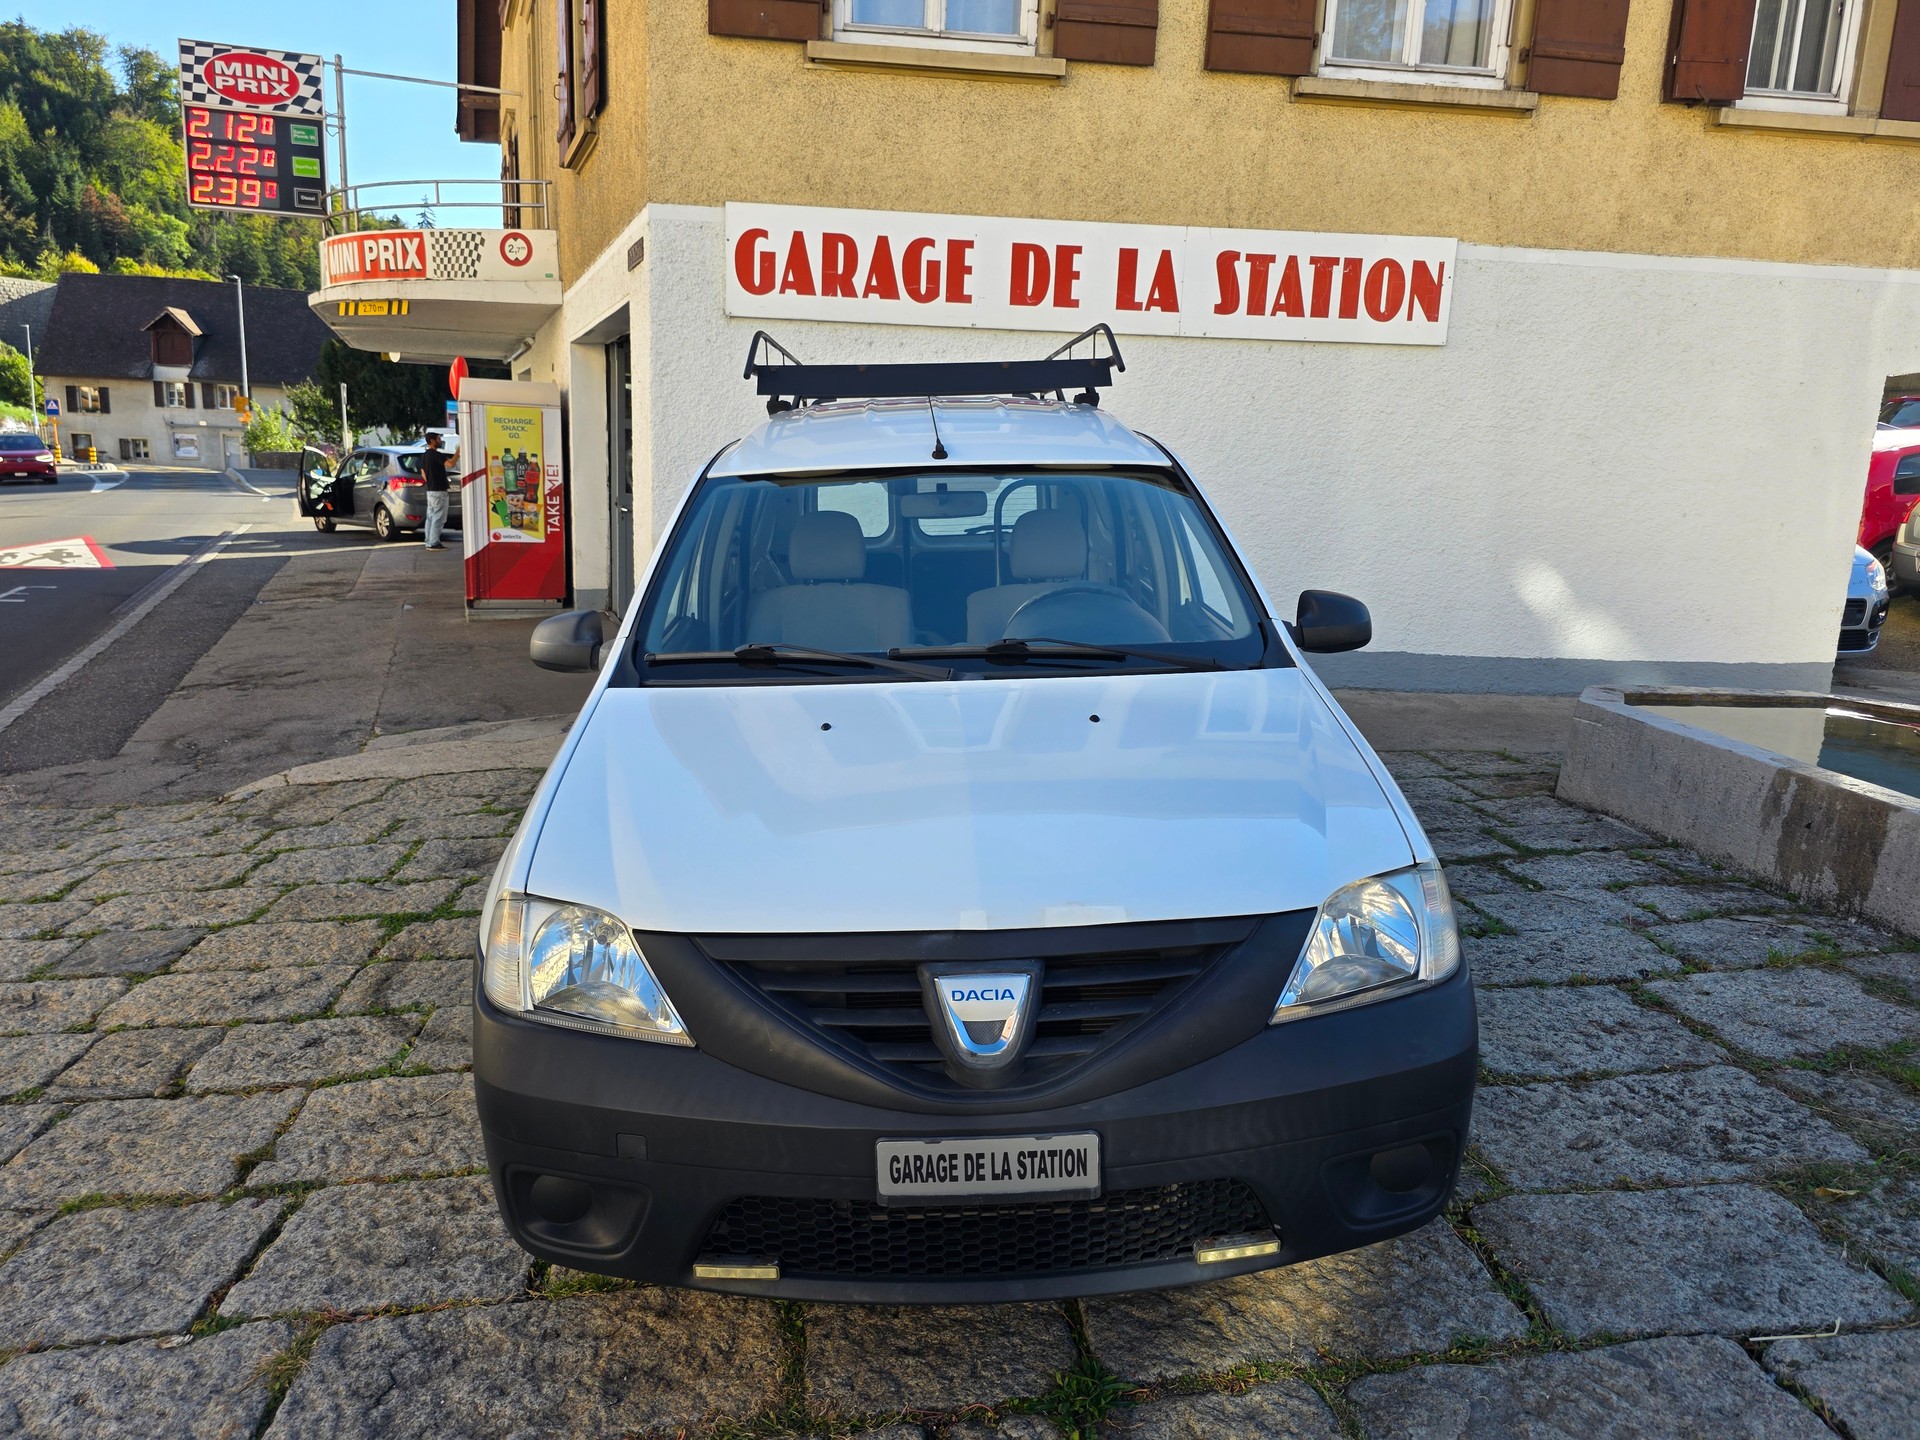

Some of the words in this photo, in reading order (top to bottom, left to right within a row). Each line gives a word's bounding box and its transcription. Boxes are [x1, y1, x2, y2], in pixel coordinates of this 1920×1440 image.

[213, 60, 290, 82] MINI
[214, 75, 292, 98] PRIX
[328, 241, 360, 277] MINI
[363, 237, 423, 272] PRIX
[734, 227, 975, 305] GARAGE
[1010, 242, 1083, 309] DE
[1115, 247, 1181, 313] LA
[1214, 249, 1445, 323] STATION
[493, 416, 536, 426] RECHARGE.
[501, 424, 529, 433] SNACK.
[546, 464, 560, 495] ME!
[547, 495, 561, 535] TAKE
[951, 988, 1015, 1002] DACIA
[889, 1153, 959, 1184] GARAGE
[964, 1152, 986, 1182] DE
[990, 1151, 1013, 1181] LA
[1016, 1148, 1088, 1181] STATION
